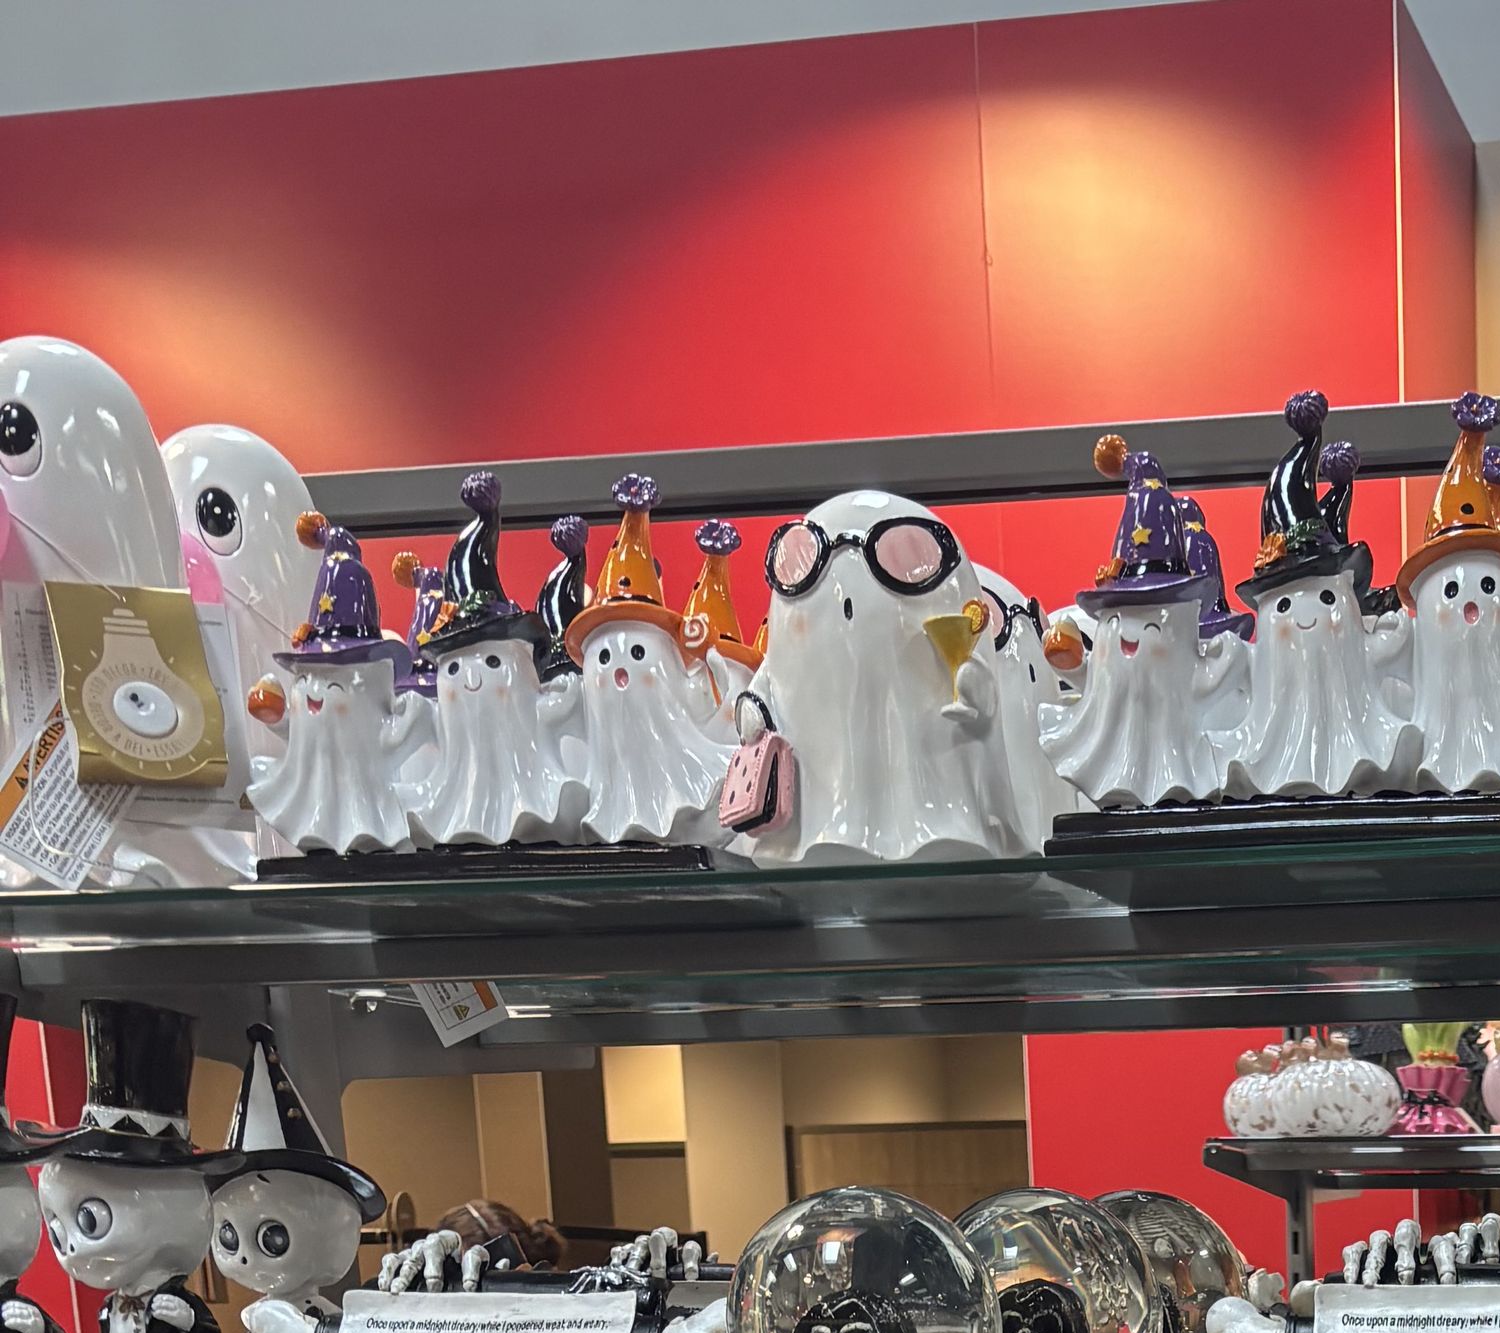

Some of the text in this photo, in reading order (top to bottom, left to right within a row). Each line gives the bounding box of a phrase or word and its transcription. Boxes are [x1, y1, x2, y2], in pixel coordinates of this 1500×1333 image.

[416, 1318, 451, 1333] midnight
[480, 1319, 501, 1331] while
[1341, 1313, 1365, 1327] Once
[1365, 1315, 1389, 1329] upon
[1390, 1317, 1396, 1327] a
[1396, 1314, 1436, 1330] midnight
[1469, 1313, 1492, 1326] while
[1493, 1314, 1498, 1326] I
